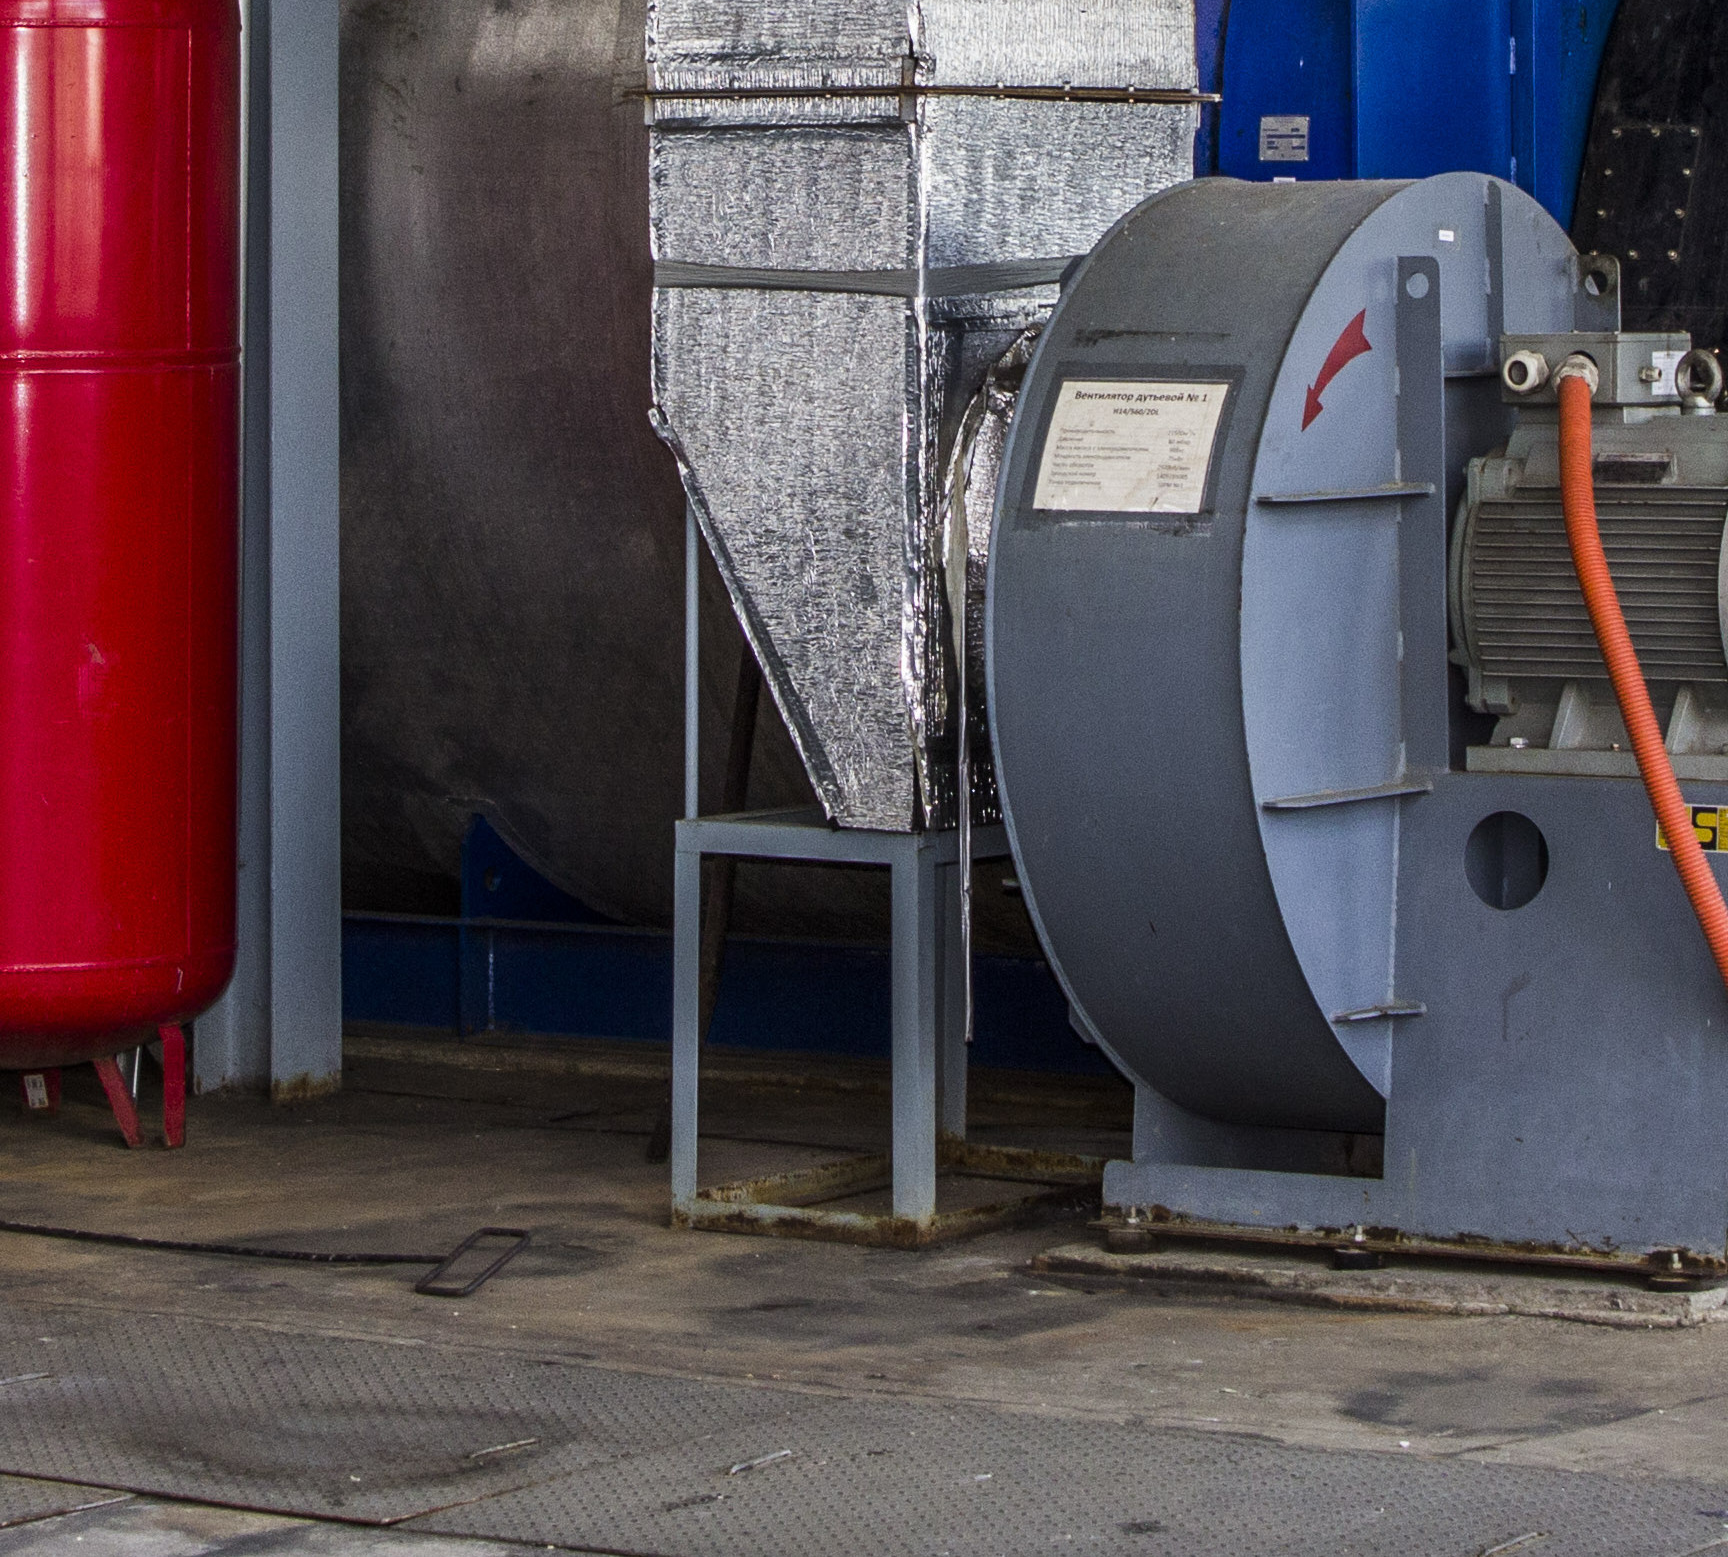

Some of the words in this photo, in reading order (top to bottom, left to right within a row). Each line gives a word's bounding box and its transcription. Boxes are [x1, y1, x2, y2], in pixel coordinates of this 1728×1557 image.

[1075, 391, 1134, 402] Вентилятор
[1136, 392, 1184, 403] дутьевой
[1186, 393, 1200, 402] №
[1201, 394, 1208, 402] 1
